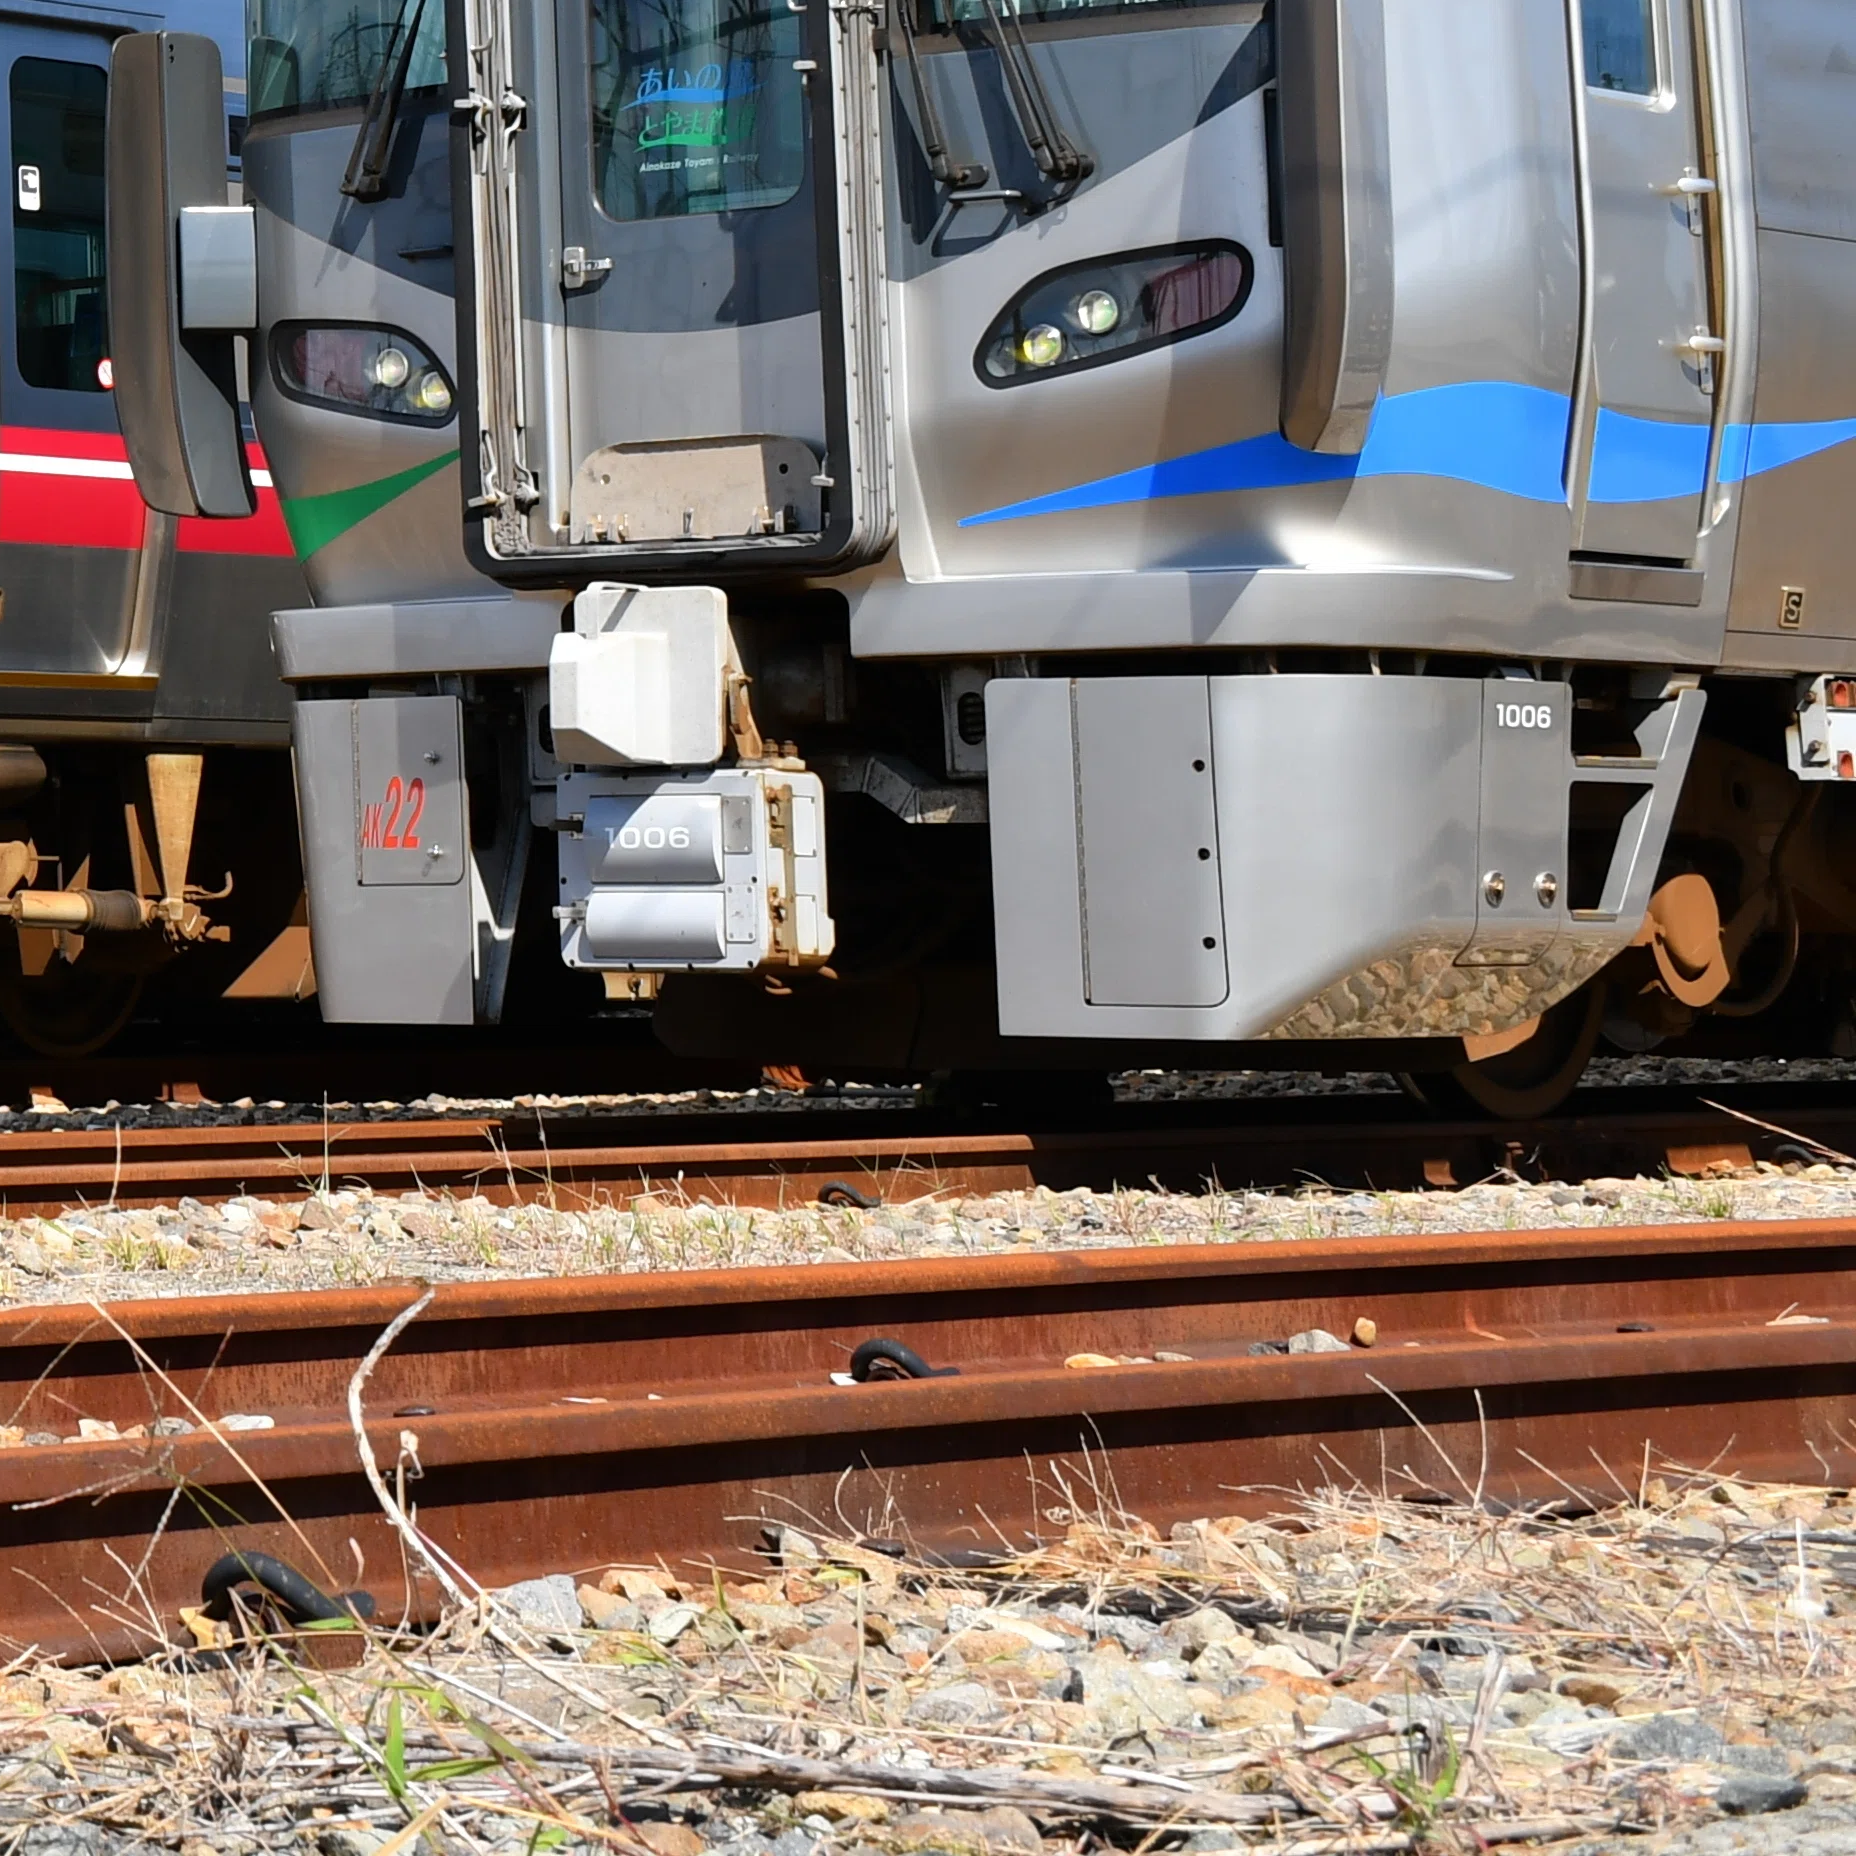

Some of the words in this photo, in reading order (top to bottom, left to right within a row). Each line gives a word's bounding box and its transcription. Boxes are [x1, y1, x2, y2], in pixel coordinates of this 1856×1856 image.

[1496, 704, 1552, 729] 1006
[362, 781, 425, 849] AK22
[605, 827, 690, 849] 1006
